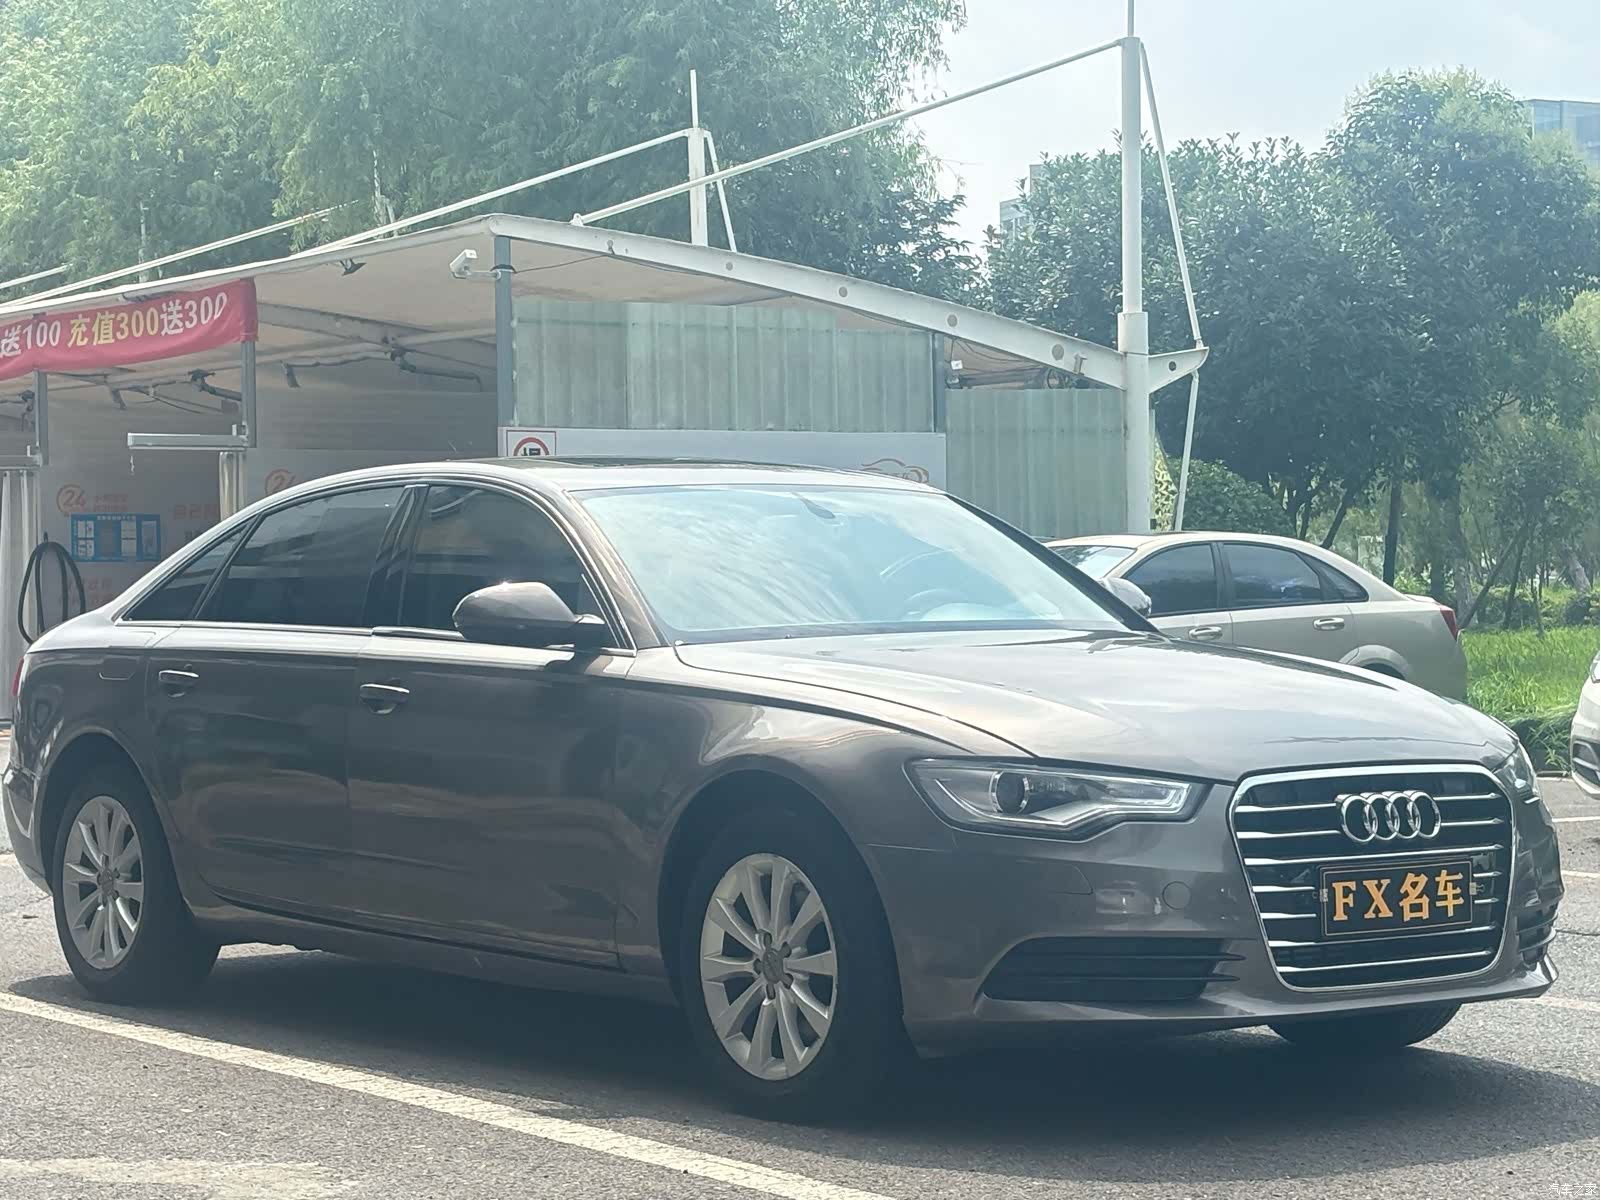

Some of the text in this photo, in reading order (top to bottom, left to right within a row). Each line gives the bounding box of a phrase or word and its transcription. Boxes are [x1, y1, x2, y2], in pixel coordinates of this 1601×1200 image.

[0, 292, 228, 358] 送100 充值300送300
